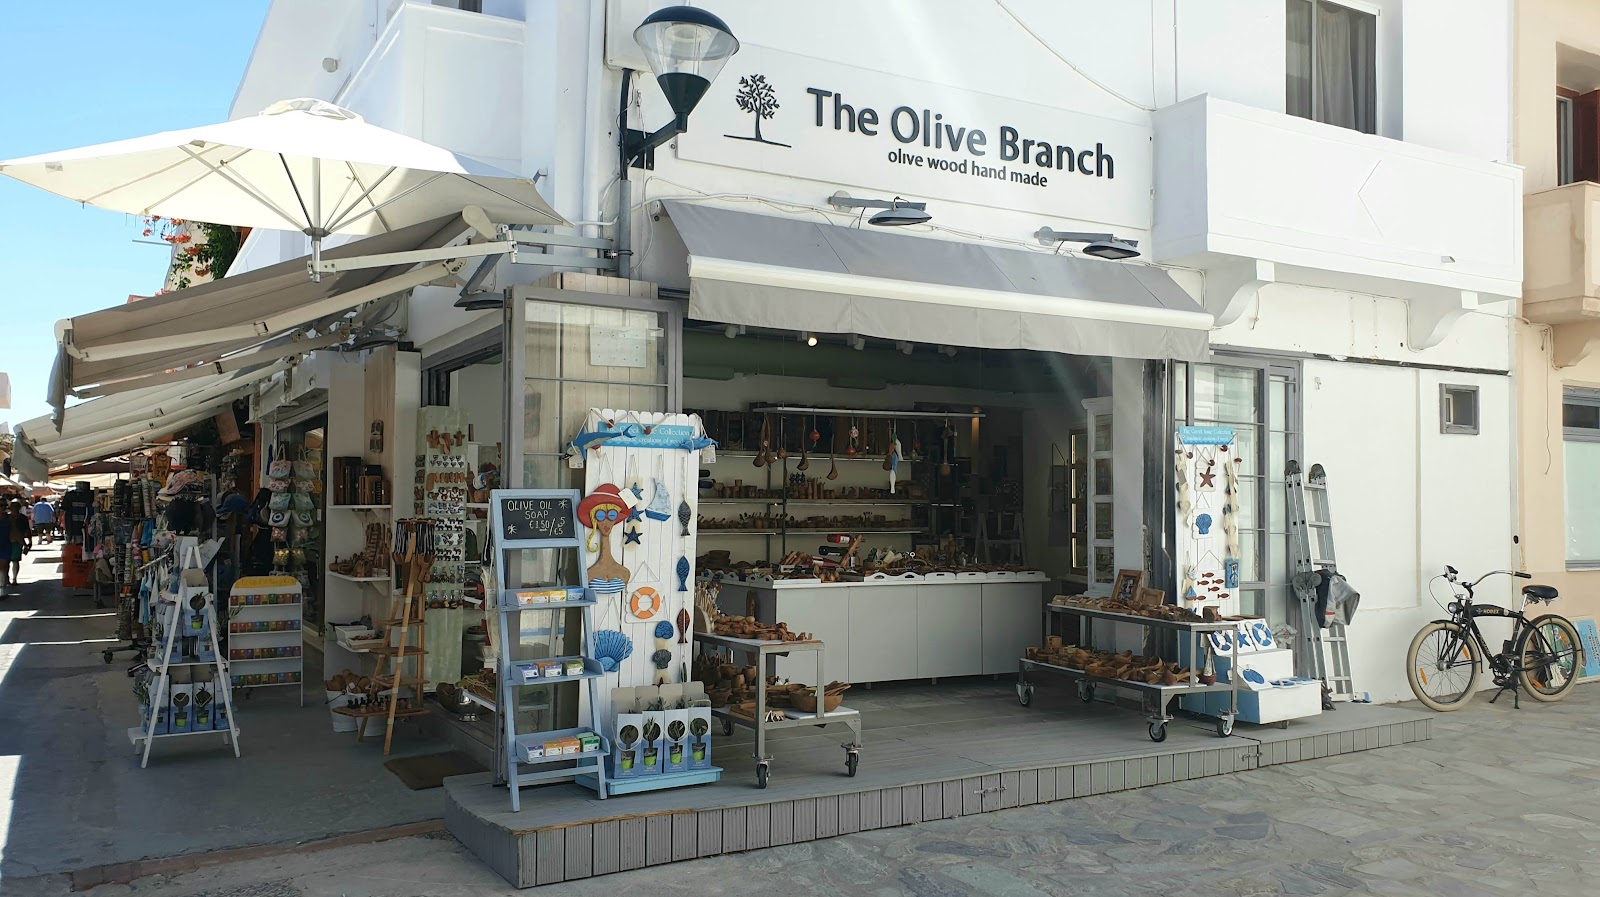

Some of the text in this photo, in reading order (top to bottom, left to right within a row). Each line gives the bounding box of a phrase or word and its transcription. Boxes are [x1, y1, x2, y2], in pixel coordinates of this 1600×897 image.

[806, 87, 1115, 179] The Olive Branch
[888, 148, 1048, 187] olive wood hand made
[660, 427, 690, 437] Collection
[507, 500, 552, 511] OLIVE OIL
[525, 510, 549, 520] SOAP
